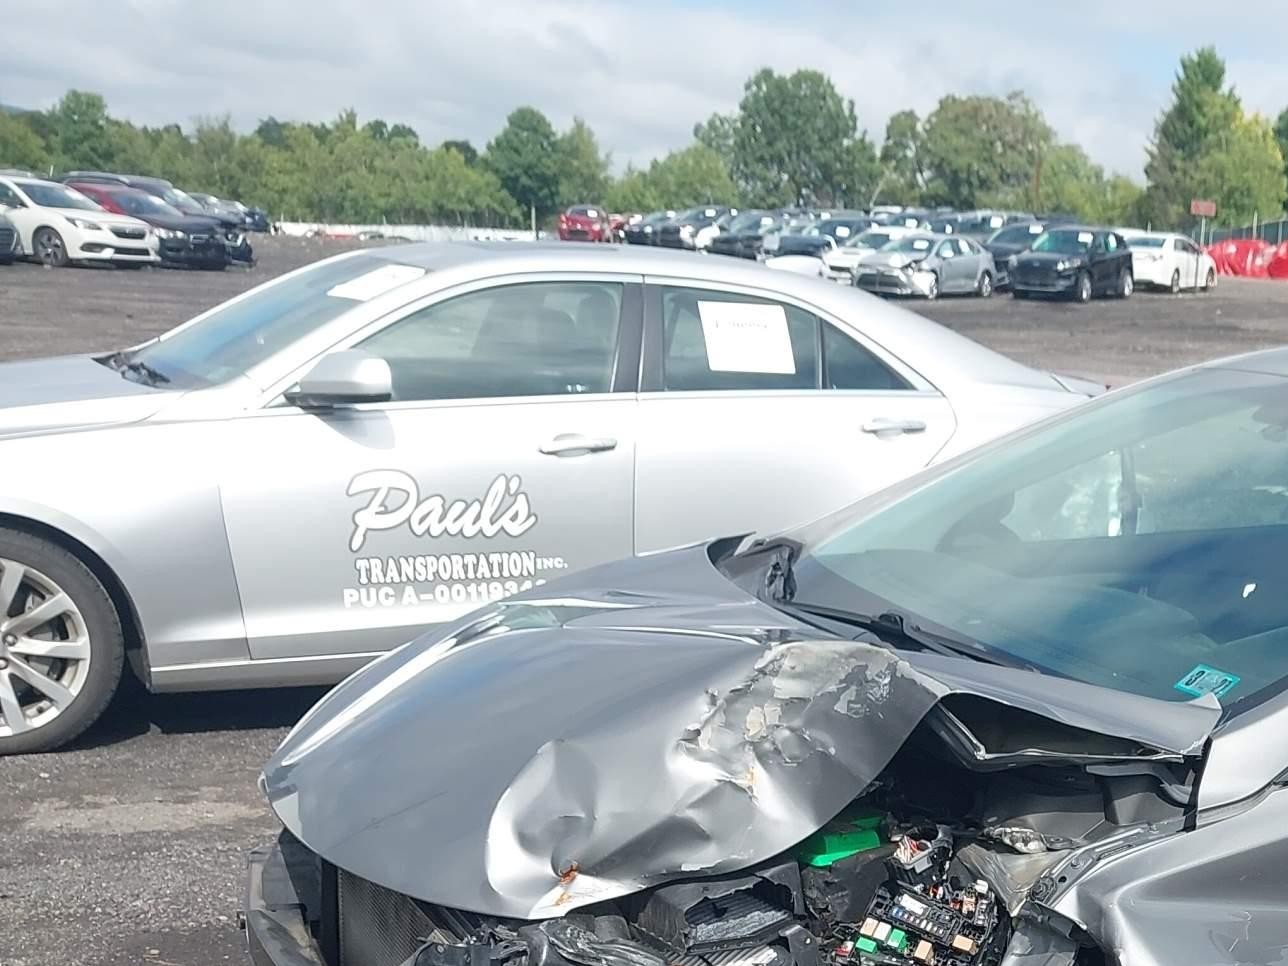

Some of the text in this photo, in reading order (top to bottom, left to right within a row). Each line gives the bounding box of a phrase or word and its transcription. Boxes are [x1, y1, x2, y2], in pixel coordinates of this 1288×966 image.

[346, 469, 538, 552] Paul's
[355, 551, 569, 585] TRANSPORTATION INC.
[343, 579, 546, 609] PUC A-001193
